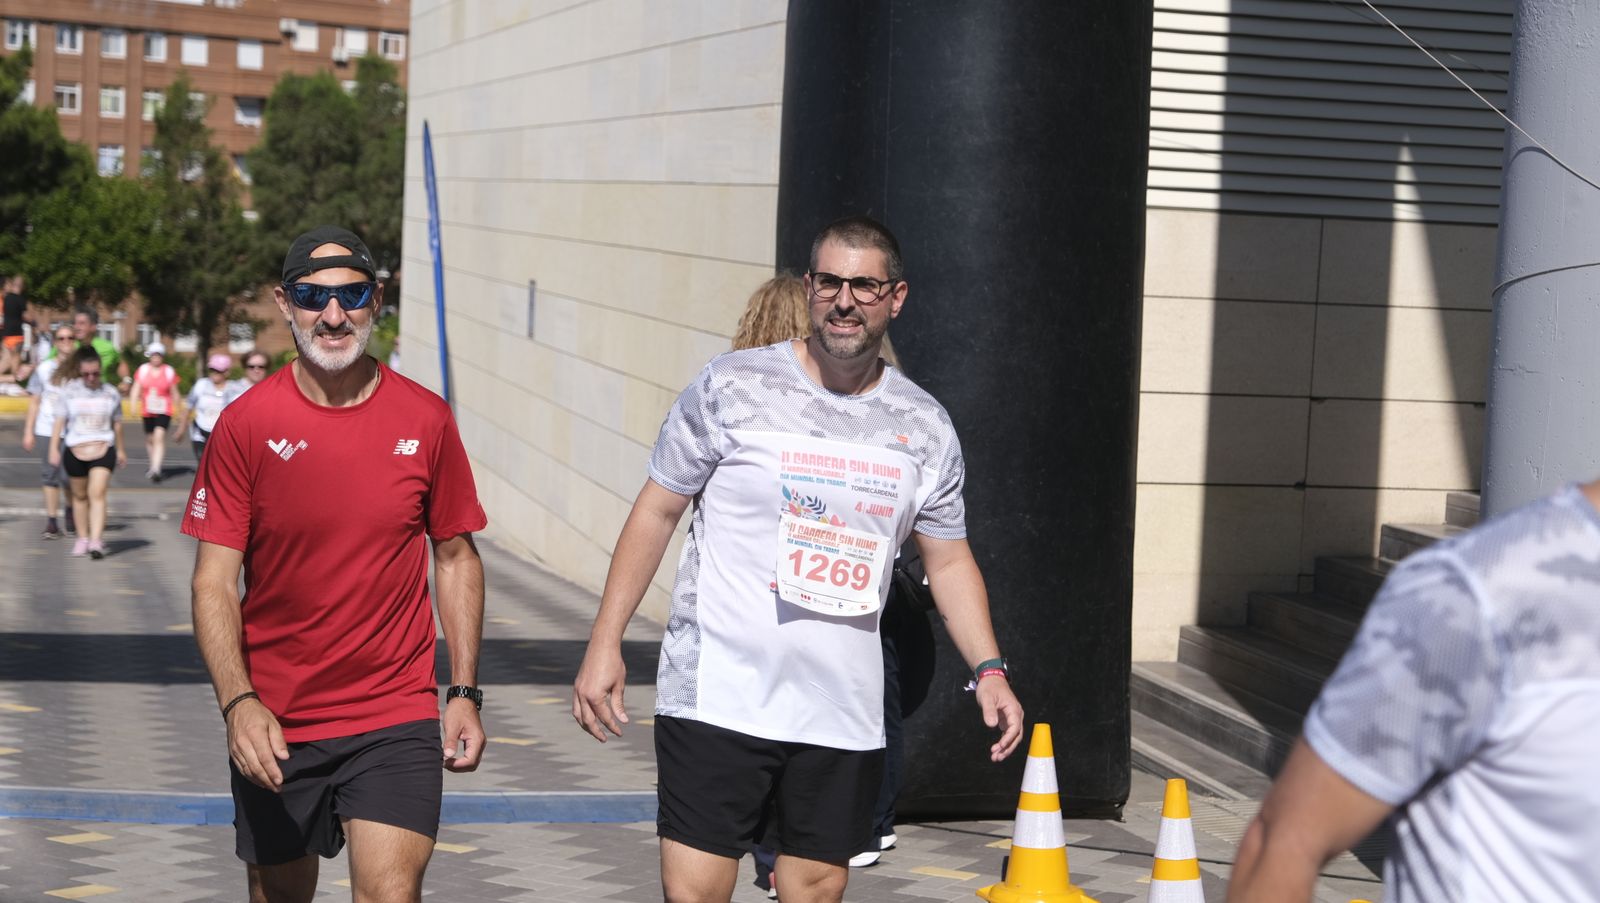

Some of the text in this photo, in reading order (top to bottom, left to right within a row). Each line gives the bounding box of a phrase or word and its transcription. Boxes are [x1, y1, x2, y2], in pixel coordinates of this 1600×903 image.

[793, 452, 846, 470] CARRERA
[849, 460, 869, 474] SIN
[872, 463, 901, 480] HUMO
[790, 474, 815, 483] MUNDIAL
[826, 478, 847, 488] TABACO
[855, 502, 894, 518] 4 JUNIO
[794, 540, 814, 549] MUNDIAL
[797, 525, 837, 541] CARRERA
[839, 534, 854, 546] SIN
[855, 537, 878, 551] HUMO
[788, 549, 871, 591] 1269
